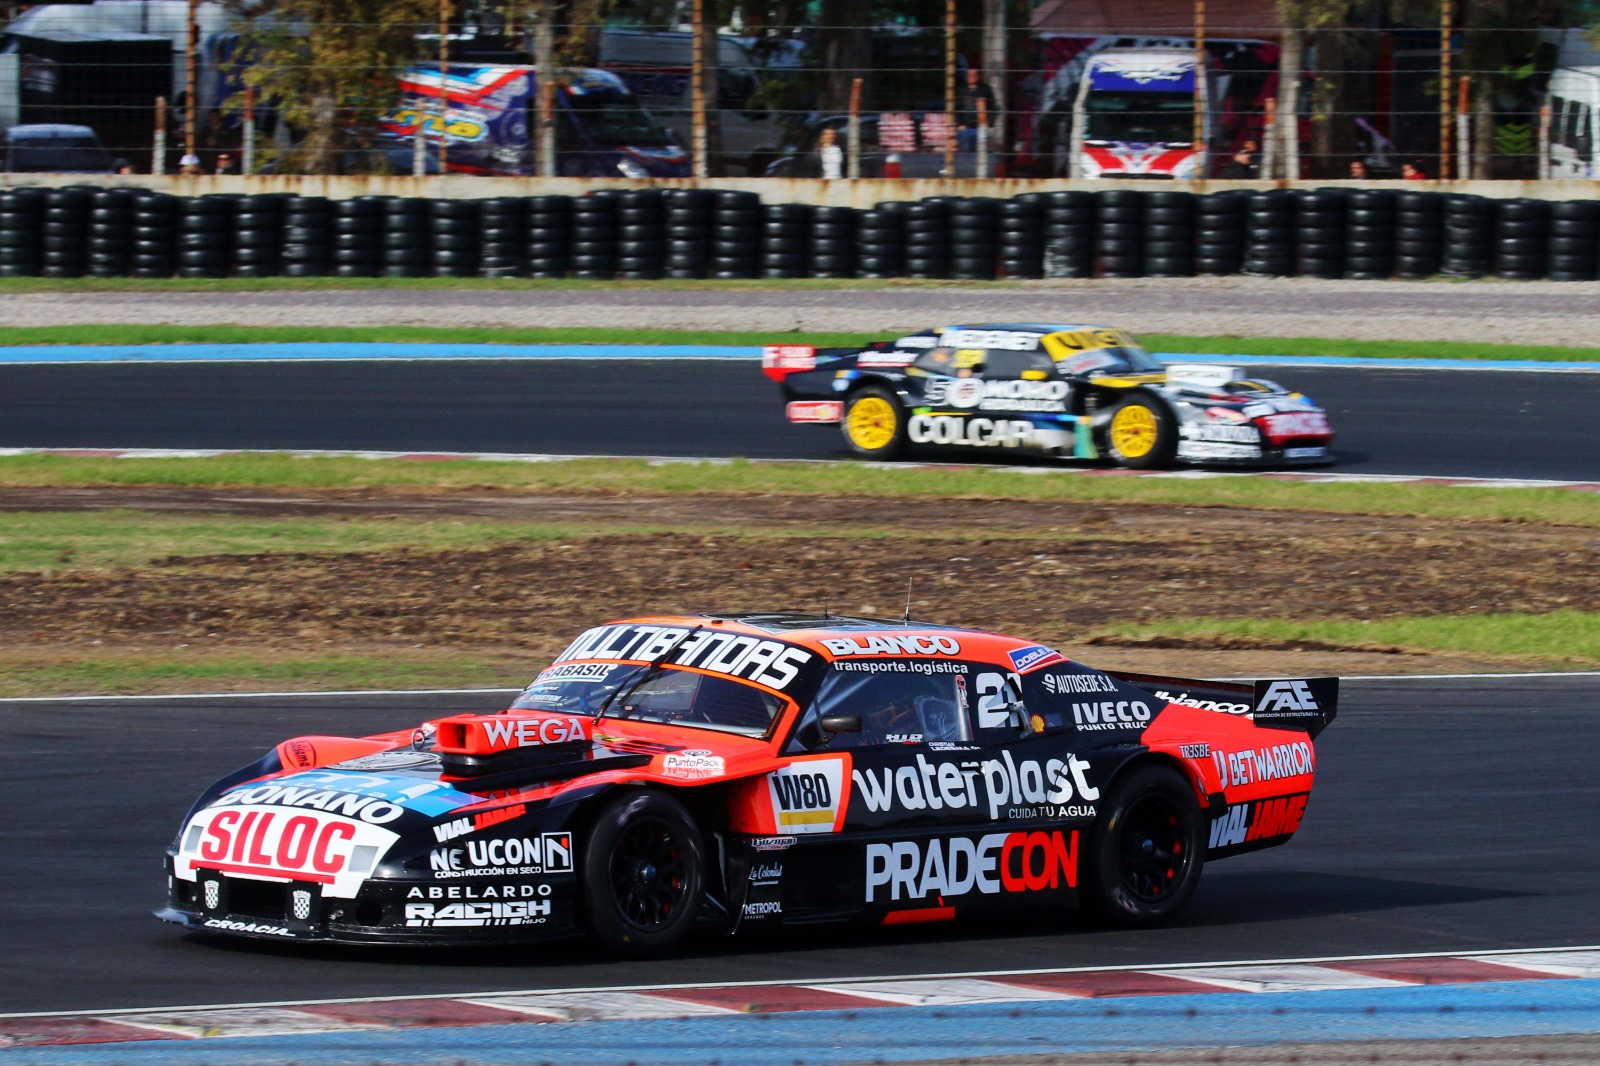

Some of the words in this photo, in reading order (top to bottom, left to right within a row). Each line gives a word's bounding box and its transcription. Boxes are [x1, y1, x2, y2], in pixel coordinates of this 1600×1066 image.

[819, 636, 960, 656] BLANCO
[834, 660, 968, 675] transporte.logística
[1015, 648, 1047, 668] DOBLE
[1056, 674, 1101, 694] AUTOSEDE
[1099, 675, 1119, 692] S.A.
[976, 672, 1022, 730] 21
[1256, 680, 1319, 712] FAE
[1072, 701, 1151, 724] IVECO
[482, 718, 587, 748] WEGA
[1076, 723, 1116, 731] PUNTO
[771, 773, 832, 811] W80
[852, 749, 1101, 821] waterplast
[210, 785, 404, 824] BONANO
[1008, 808, 1038, 819] CUIDA
[1058, 805, 1096, 817] AGUA
[201, 810, 356, 874] SILOC
[434, 867, 505, 879] CONSTRUCCIÓN
[506, 867, 518, 876] EN
[519, 866, 542, 875] SECO
[865, 830, 1080, 903] PRADECON
[406, 884, 552, 899] ABELARDO
[744, 902, 782, 915] METROPOL
[204, 919, 296, 937] CROACIA
[522, 917, 547, 925] HIJO
